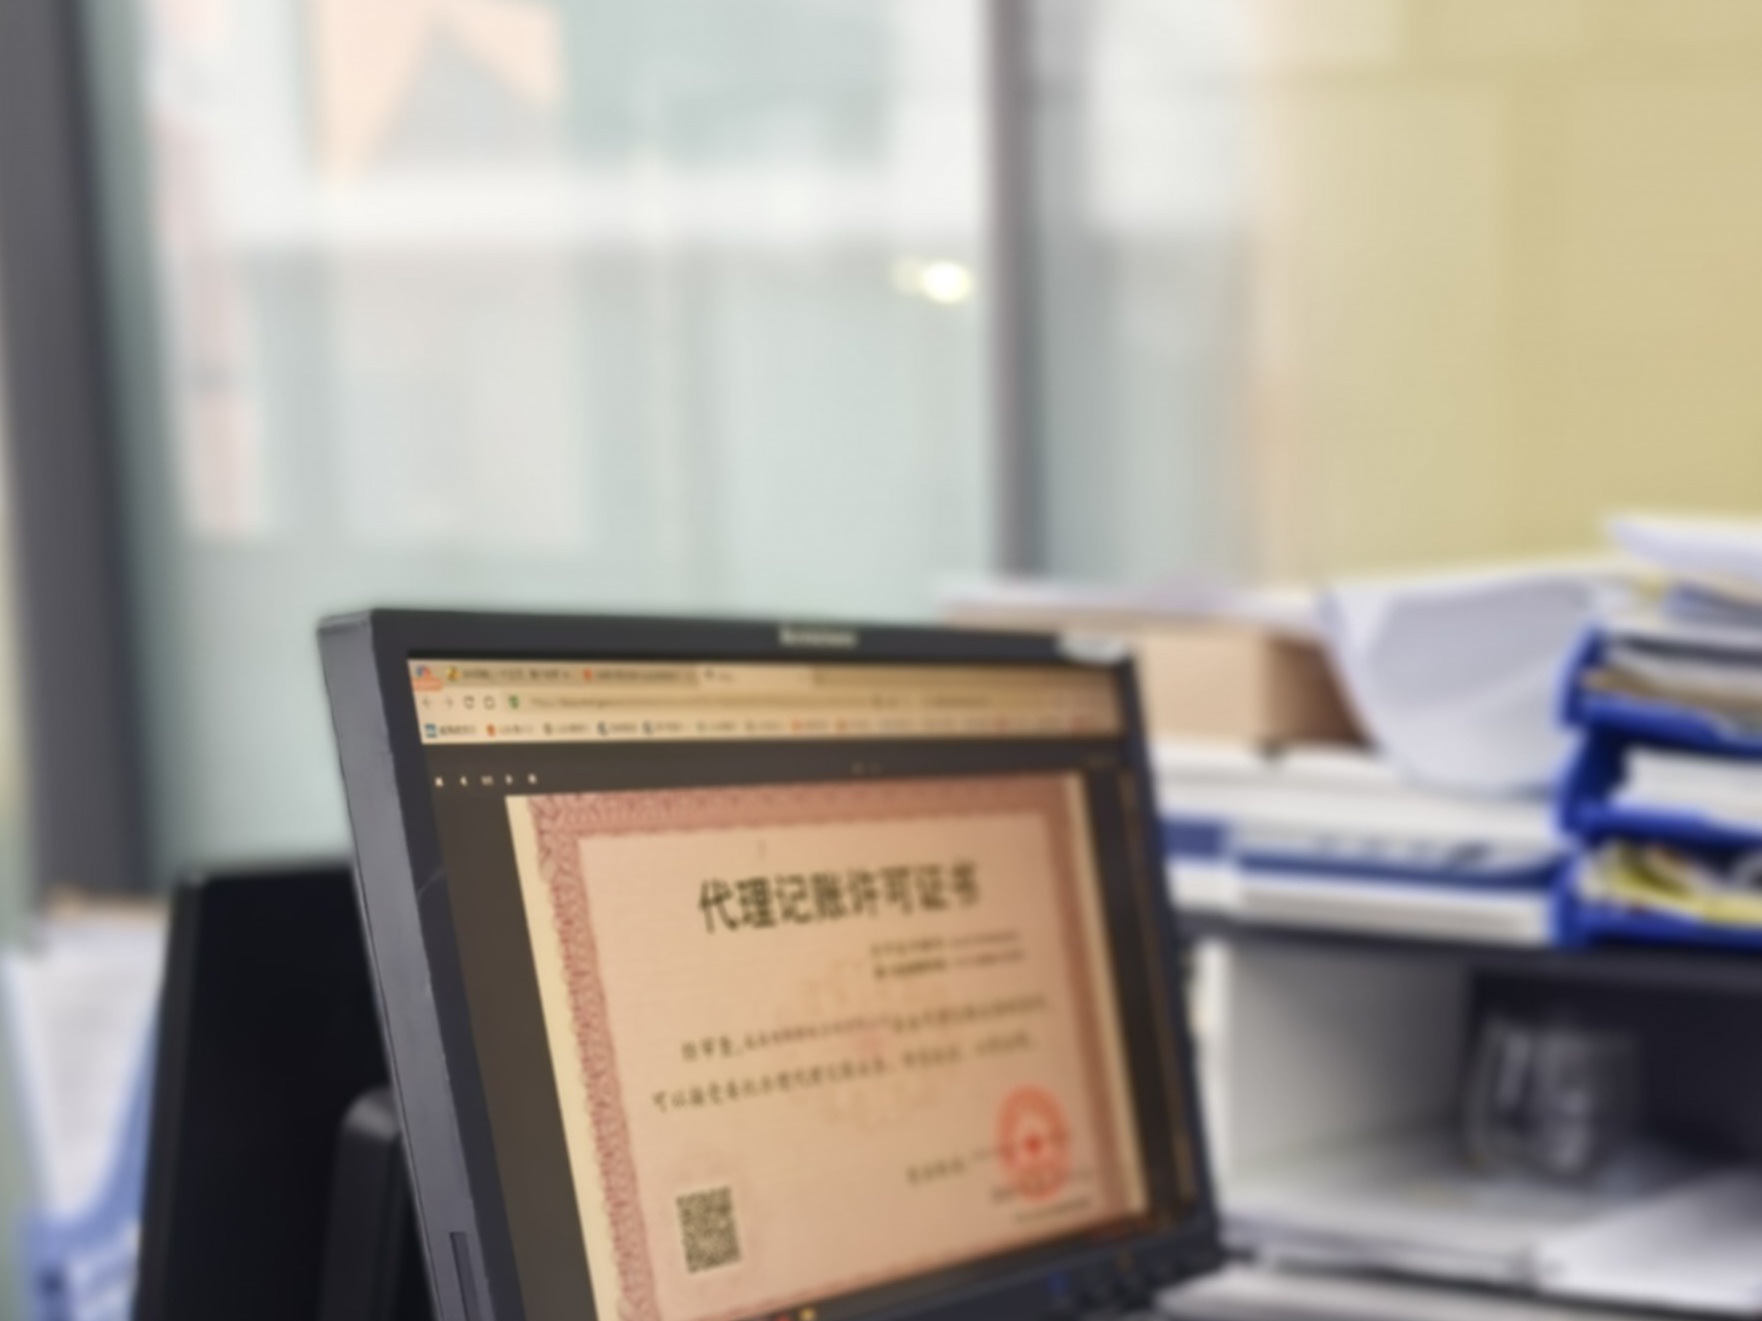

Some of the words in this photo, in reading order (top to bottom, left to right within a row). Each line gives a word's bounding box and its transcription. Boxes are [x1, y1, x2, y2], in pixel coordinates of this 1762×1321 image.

[697, 860, 981, 934] 代理记账许可证书
